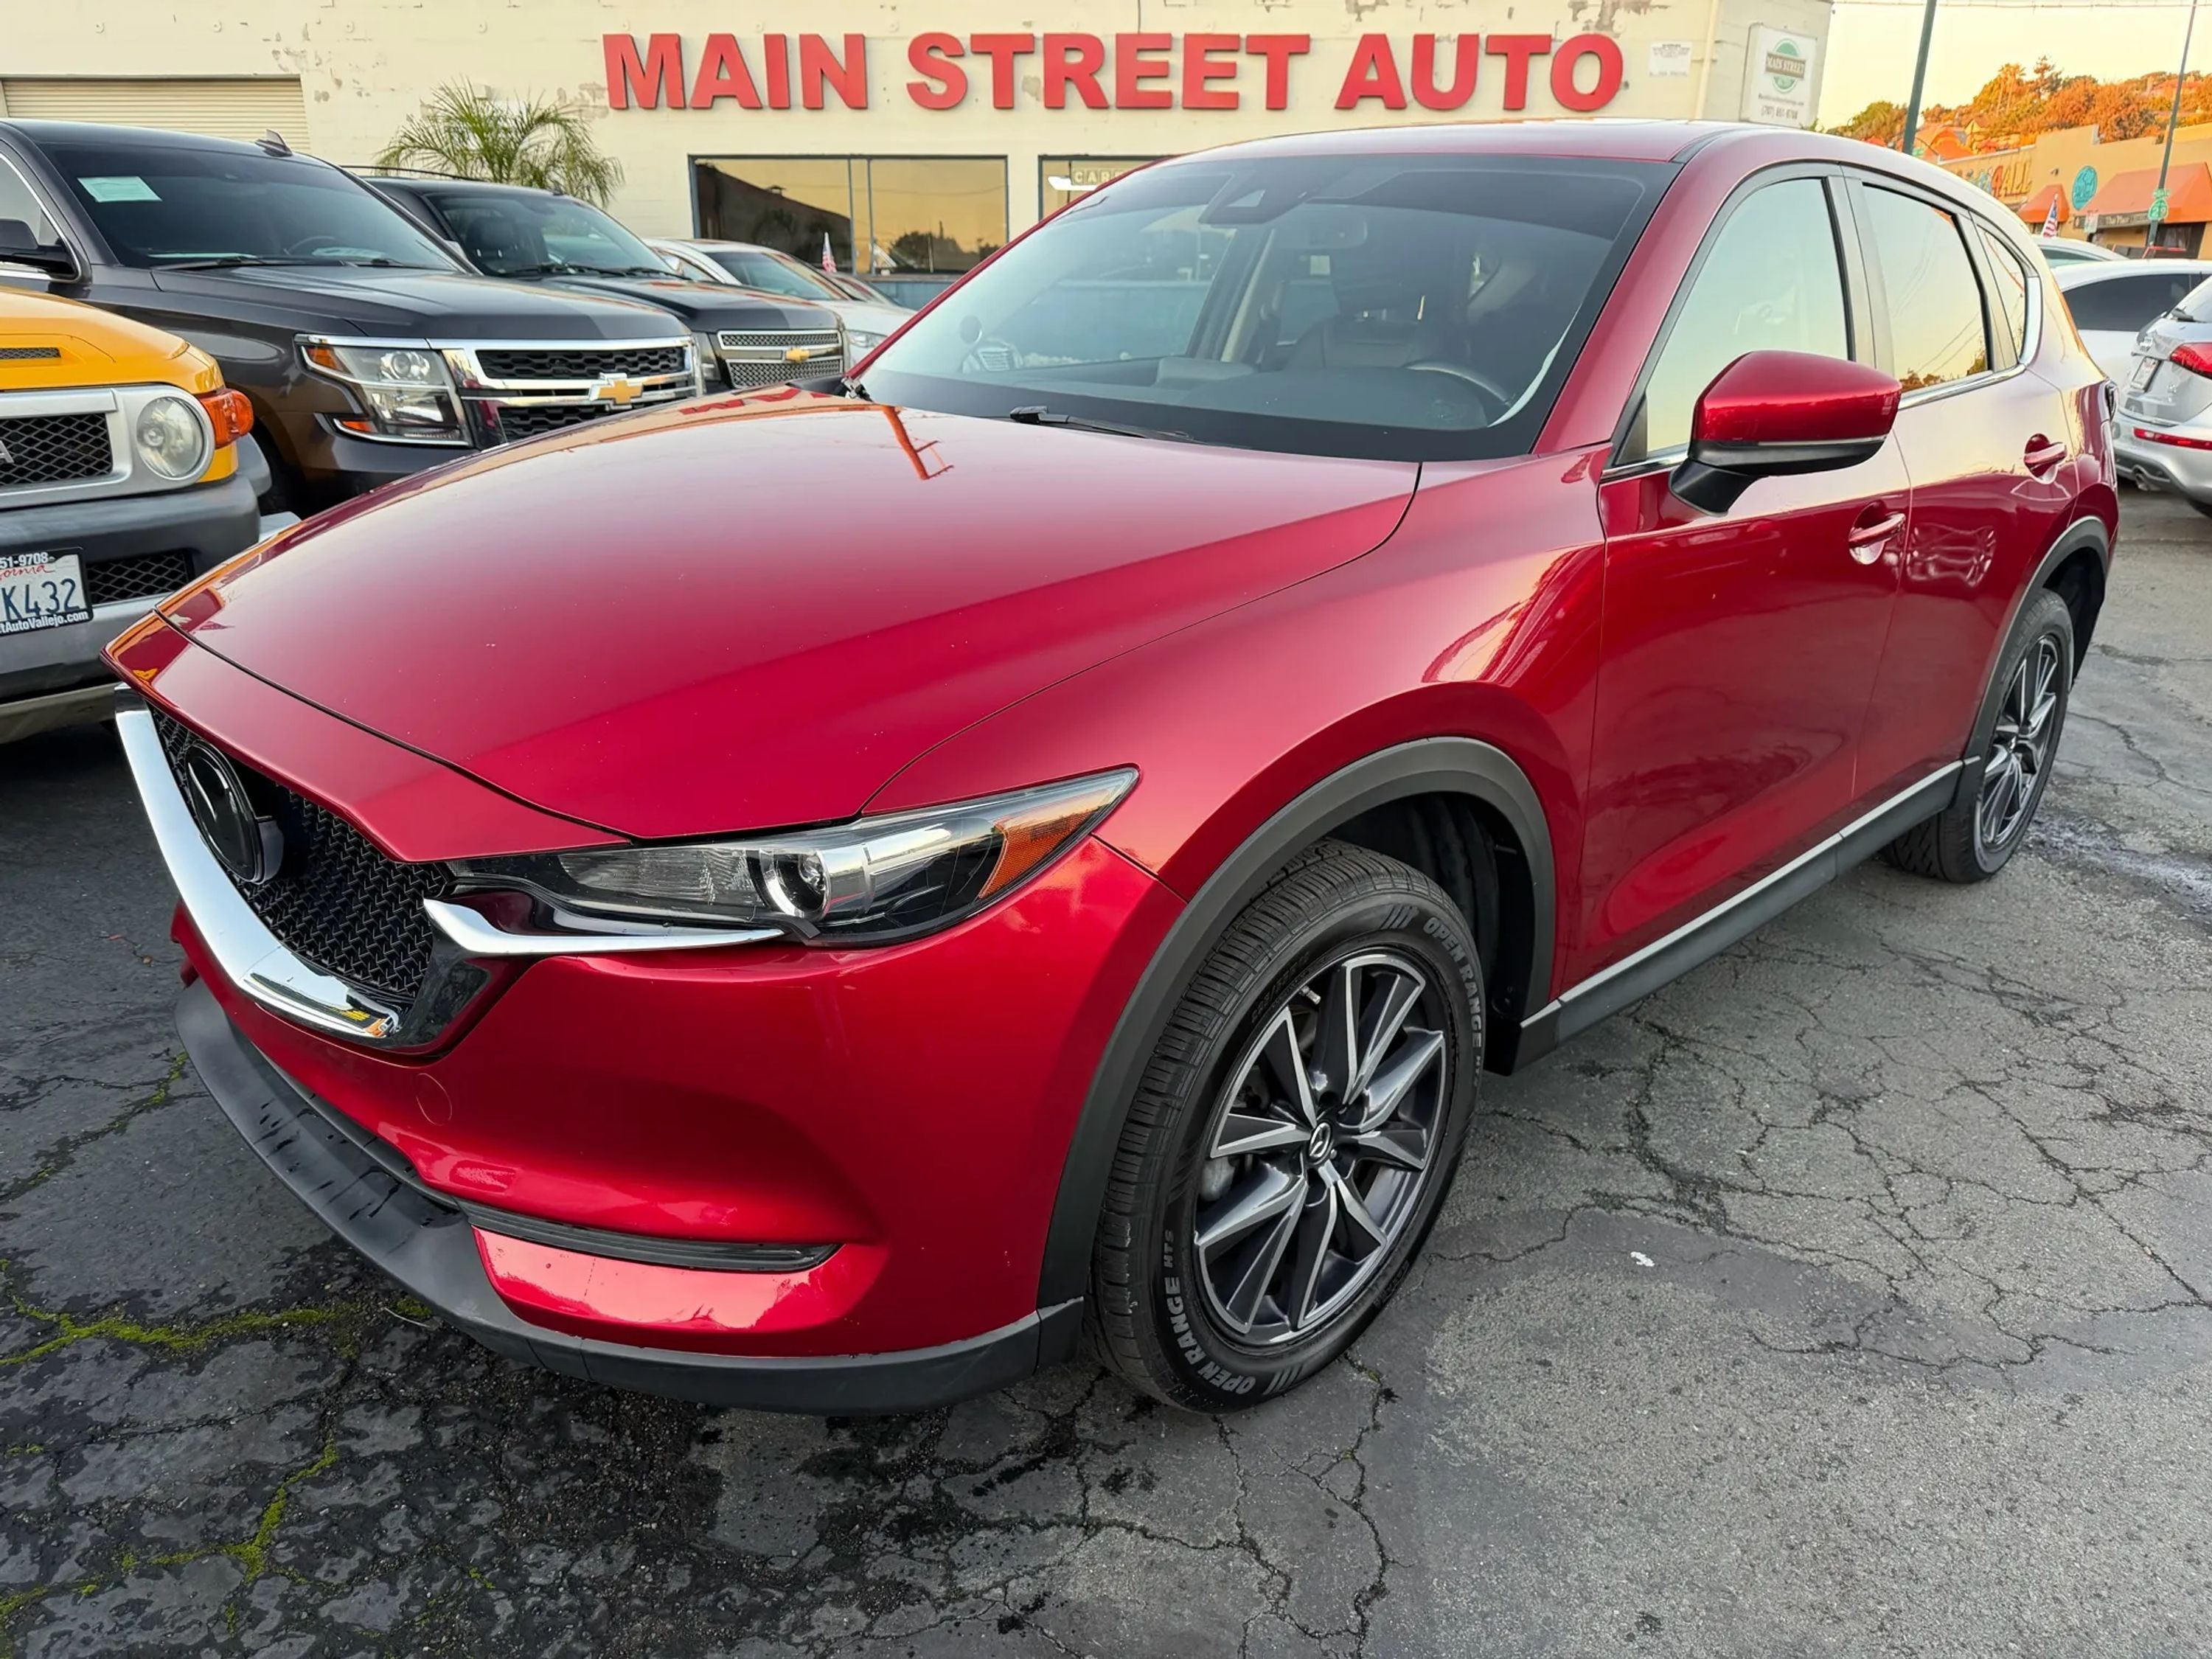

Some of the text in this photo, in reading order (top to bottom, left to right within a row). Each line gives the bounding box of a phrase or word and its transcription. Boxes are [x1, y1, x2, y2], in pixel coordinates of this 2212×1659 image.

[602, 32, 1624, 112] MAIN STREET AUTO
[1783, 59, 1804, 73] STREET
[1, 577, 80, 621] K432
[1422, 916, 1467, 963] OPEN
[1458, 963, 1483, 1048] RANGE
[1163, 1229, 1256, 1395] OPEN RANGE HTS
